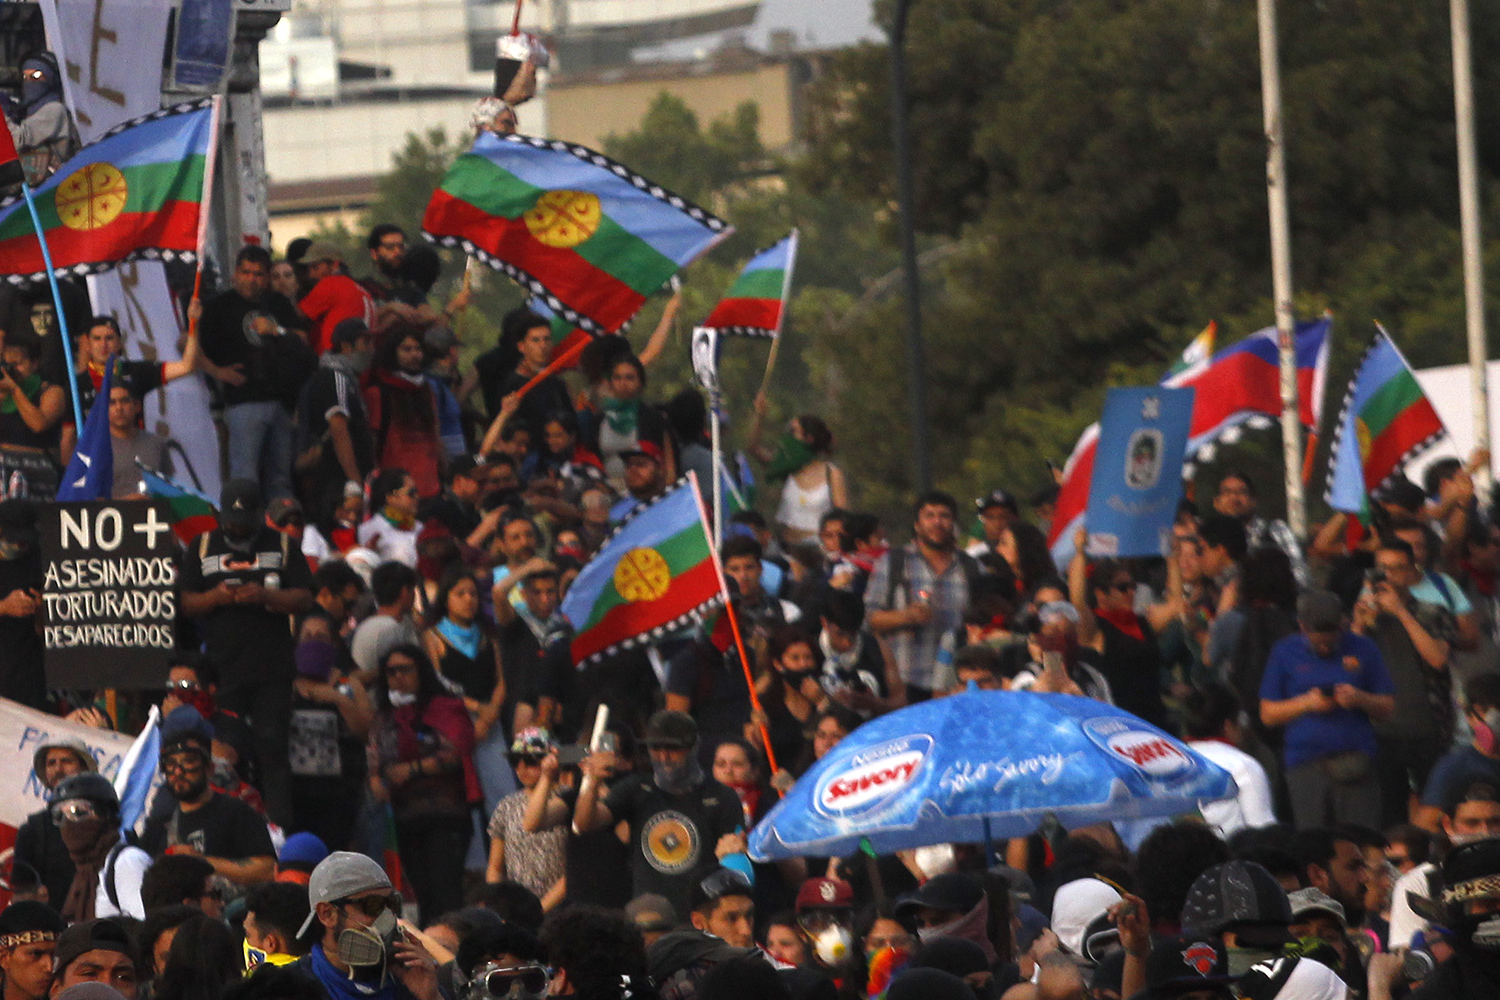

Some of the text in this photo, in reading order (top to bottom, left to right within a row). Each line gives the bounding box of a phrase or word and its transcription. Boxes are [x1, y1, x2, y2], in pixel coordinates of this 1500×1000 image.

[60, 507, 123, 551] NO
[44, 557, 175, 590] ASESINADOS
[42, 590, 176, 621] TORTURADOS
[44, 623, 175, 649] DESAPARECIDOS
[826, 758, 919, 804] Savory
